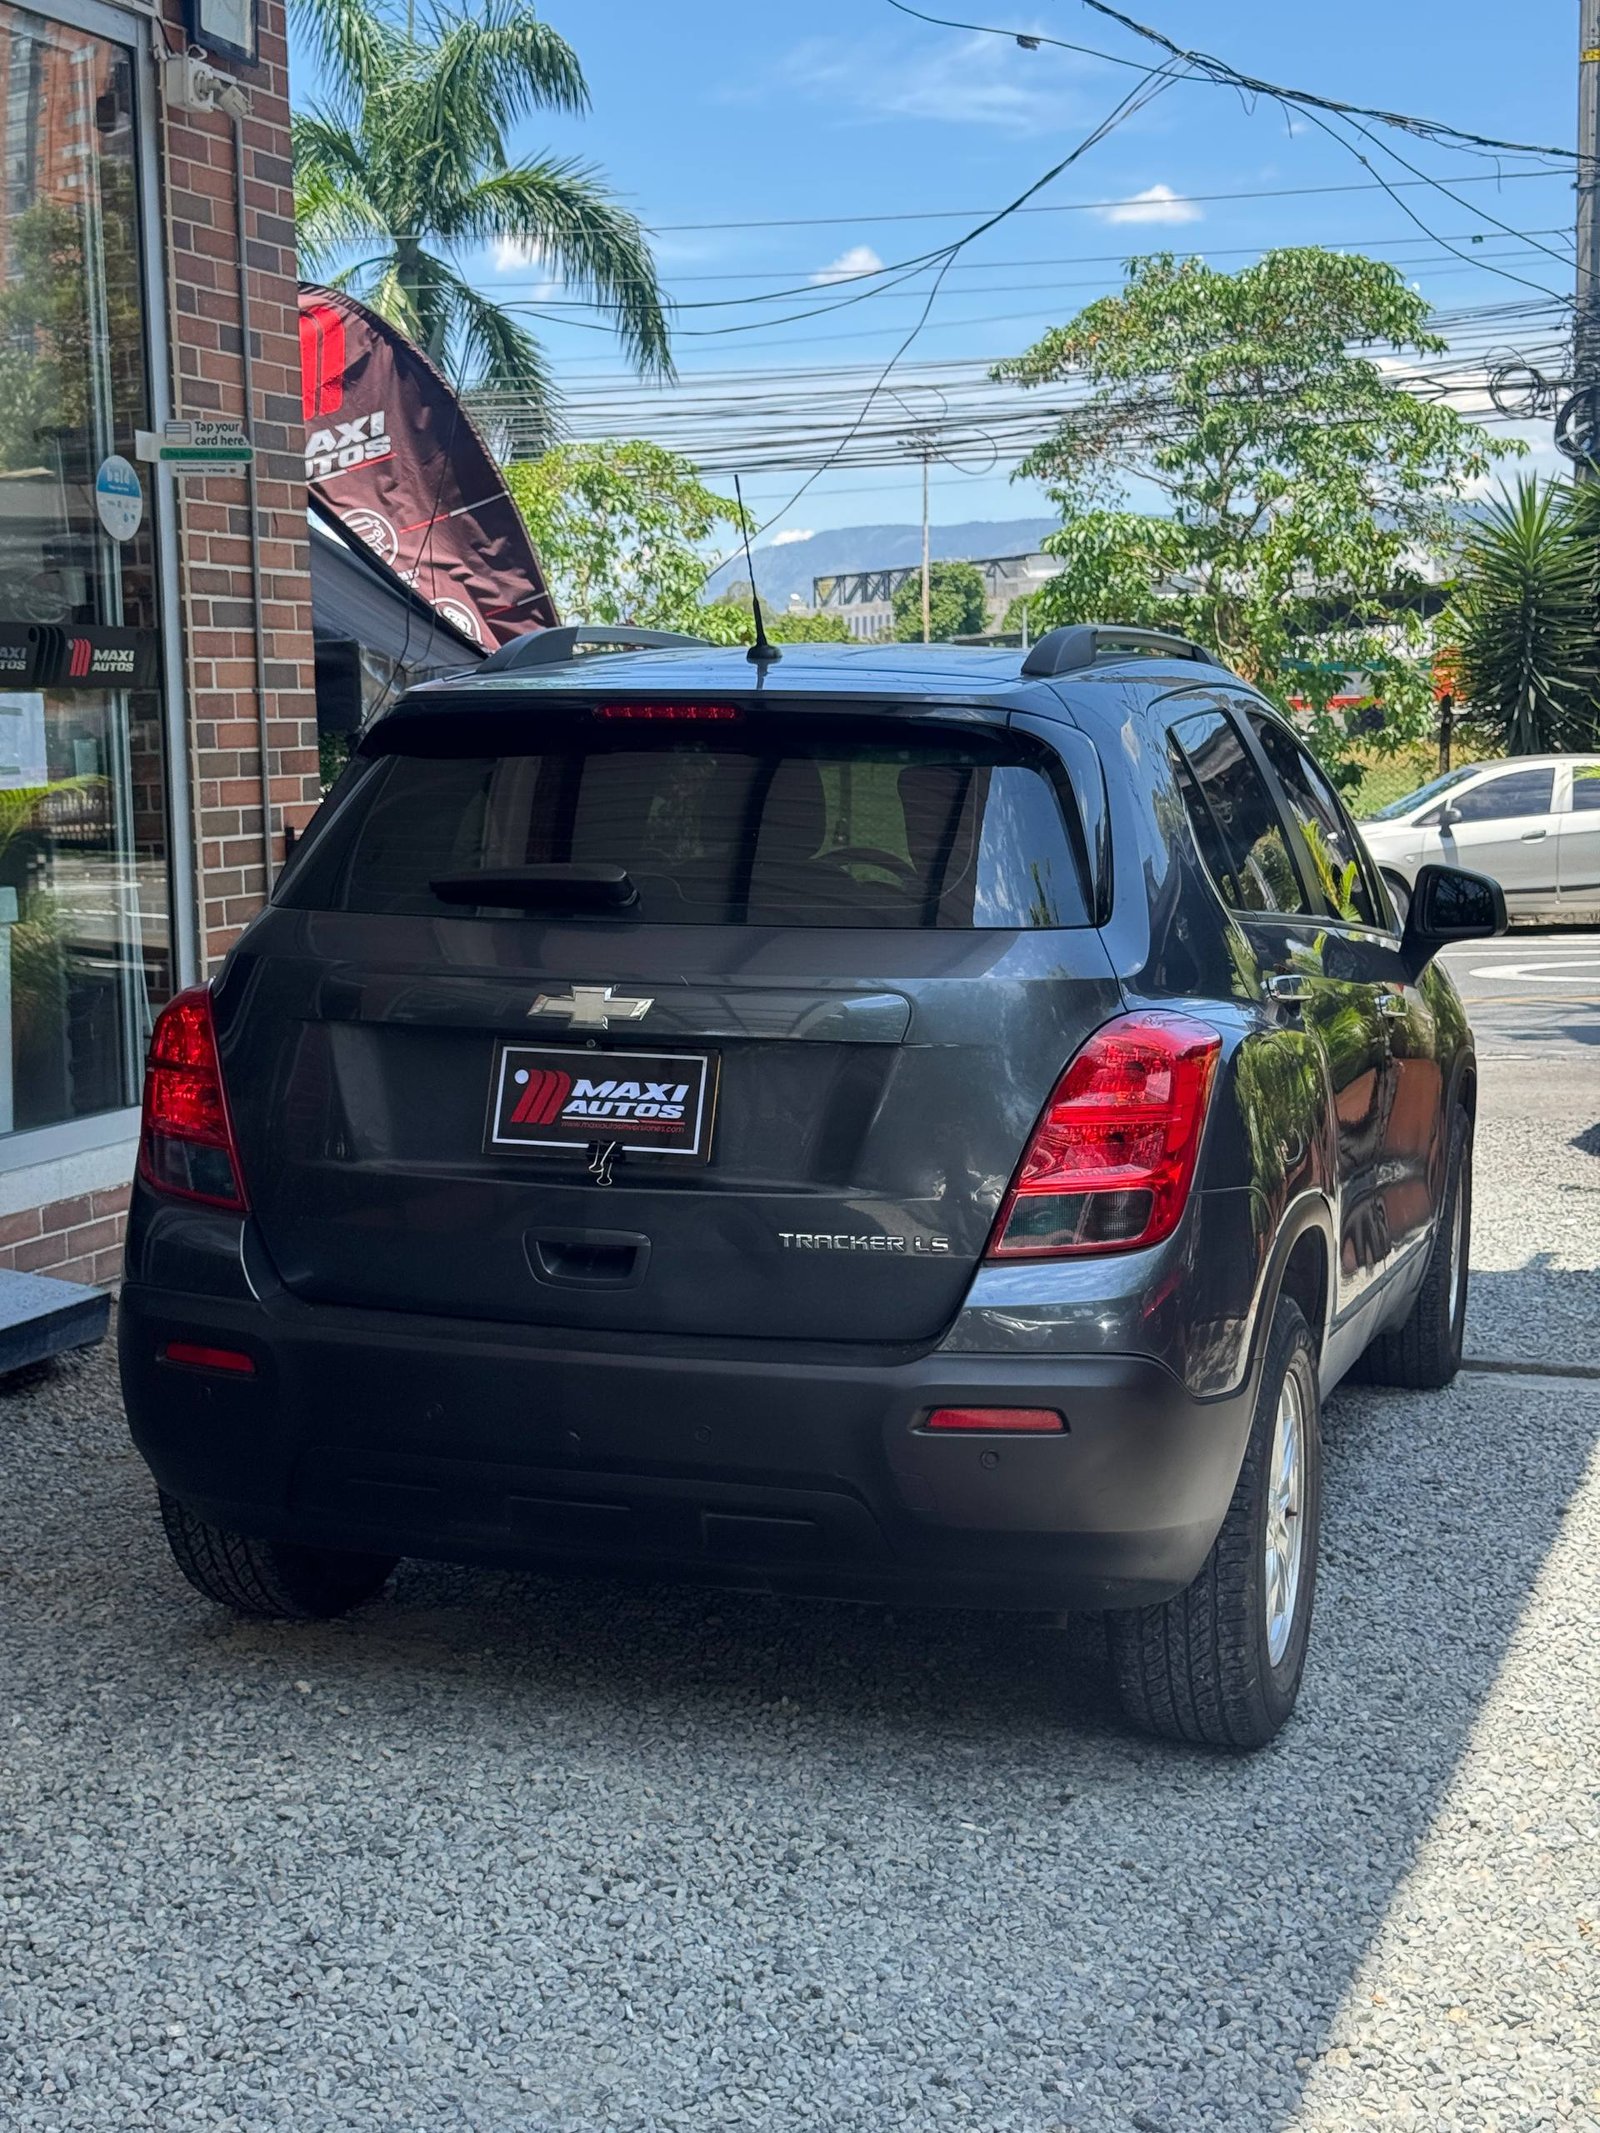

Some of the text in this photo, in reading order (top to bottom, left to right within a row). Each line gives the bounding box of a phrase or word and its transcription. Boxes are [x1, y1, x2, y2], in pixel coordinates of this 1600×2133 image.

[195, 422, 240, 434] Tap your
[305, 411, 385, 458] AXI
[195, 436, 247, 446] card here.
[305, 435, 391, 479] TOS
[0, 647, 27, 660] AXI
[93, 649, 135, 662] MAXI
[0, 660, 27, 671] TOS
[91, 662, 134, 672] AUTOS
[571, 1079, 690, 1103] MAXI
[562, 1100, 685, 1119] AUTOS
[778, 1233, 949, 1252] TRACKER LS
